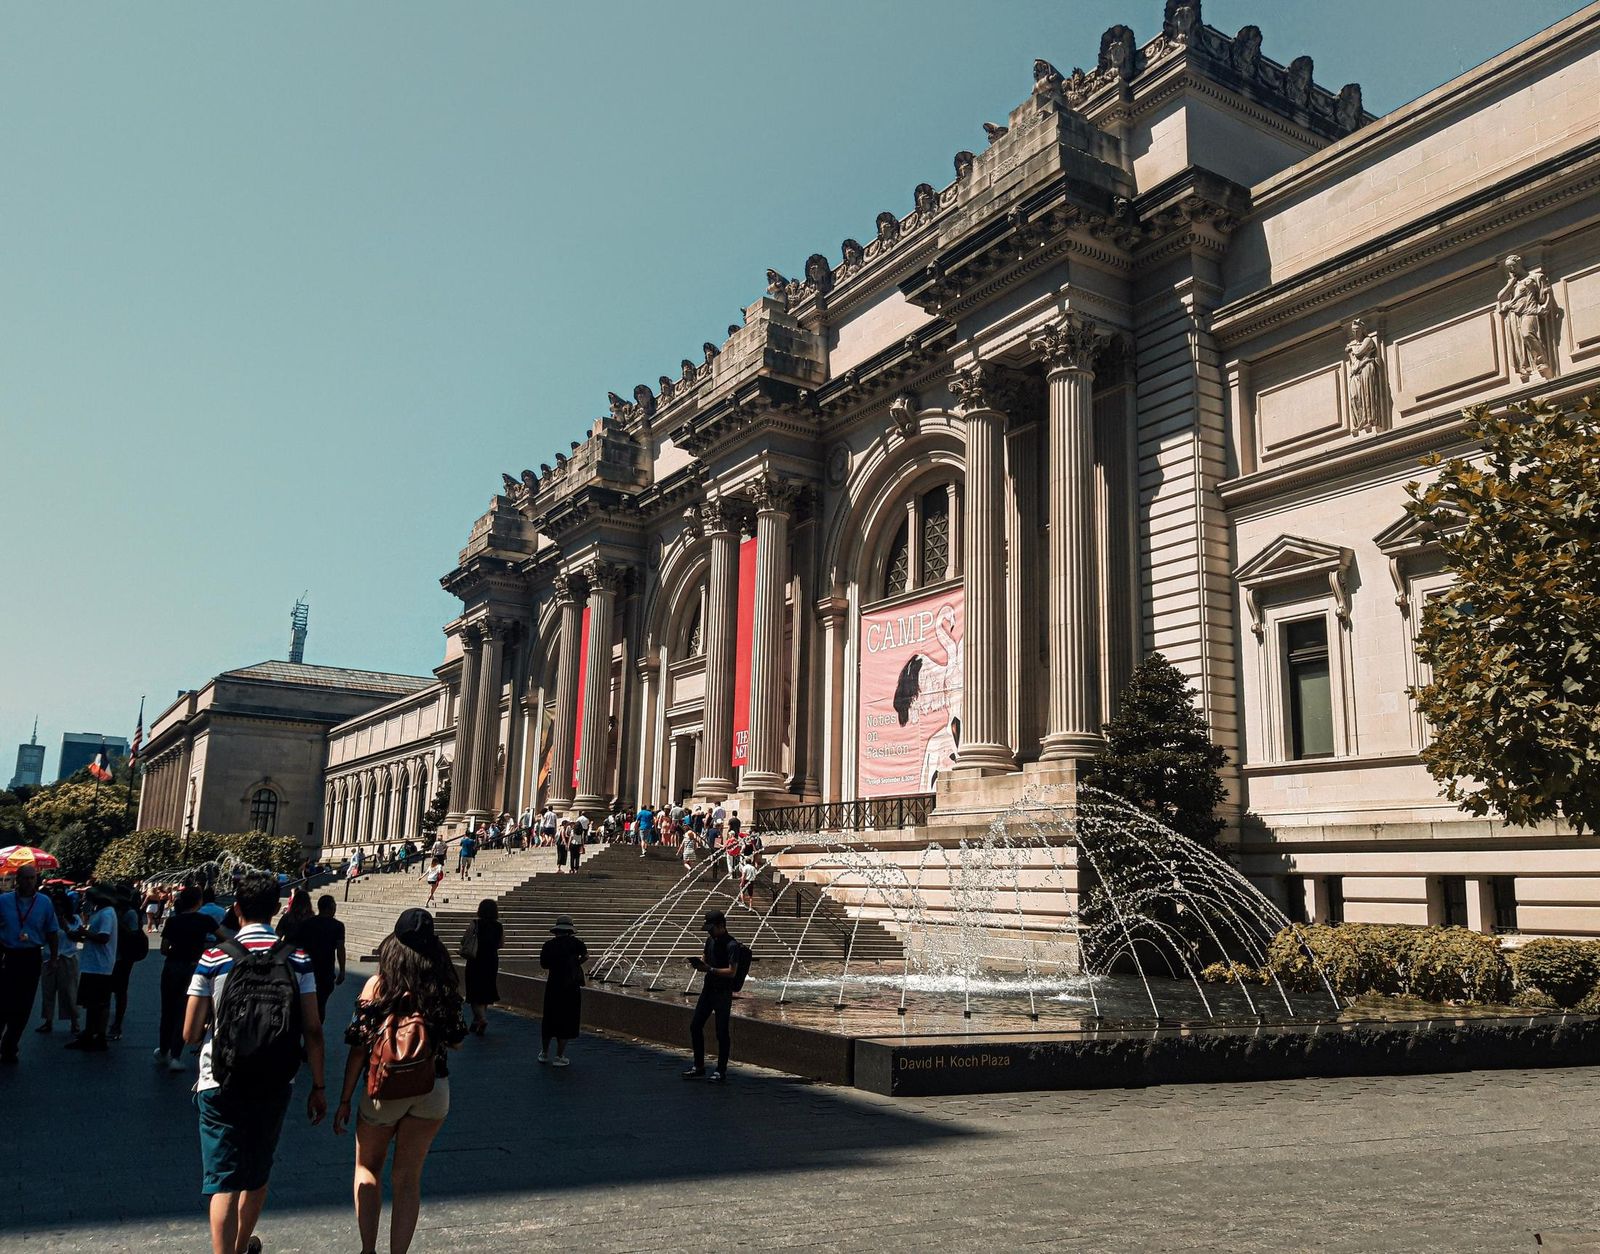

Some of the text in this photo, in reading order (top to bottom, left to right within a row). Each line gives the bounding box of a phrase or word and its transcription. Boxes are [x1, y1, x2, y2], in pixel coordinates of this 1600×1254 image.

[866, 611, 935, 654] CAMP
[866, 714, 897, 728] Notes
[735, 730, 749, 745] THE
[866, 731, 879, 743] on
[735, 744, 748, 759] MET
[866, 743, 910, 759] Fashion
[900, 1056, 932, 1070] David
[950, 1055, 979, 1068] Koch
[981, 1054, 1010, 1067] Plaza
